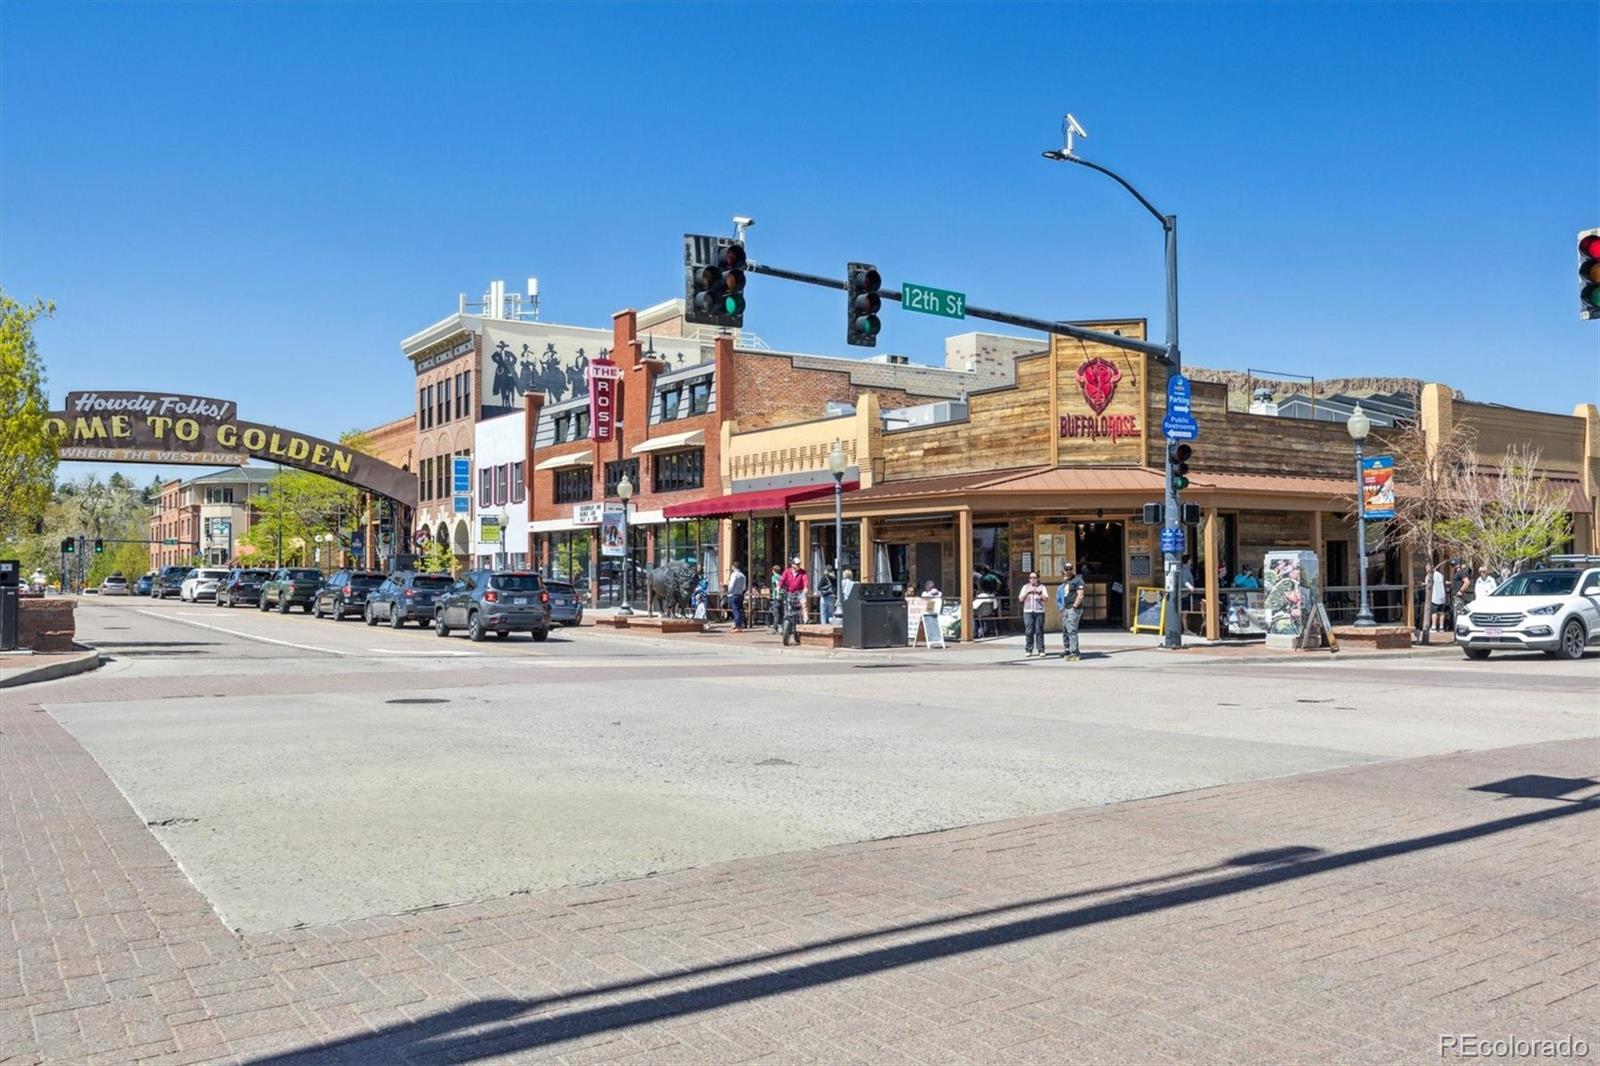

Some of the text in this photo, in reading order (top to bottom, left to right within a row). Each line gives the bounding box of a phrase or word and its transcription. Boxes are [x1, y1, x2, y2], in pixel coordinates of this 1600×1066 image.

[905, 287, 962, 315] 12th St
[594, 368, 617, 376] THE
[75, 392, 230, 421] Howdy Folks!
[1169, 395, 1190, 406] Parking
[598, 382, 609, 437] ROSE
[1164, 422, 1196, 431] Restrooms
[1170, 416, 1189, 424] Public
[147, 416, 200, 442] TO
[216, 424, 353, 474] GOLDEN
[61, 448, 242, 464] WHERE THE WEST LIVES
